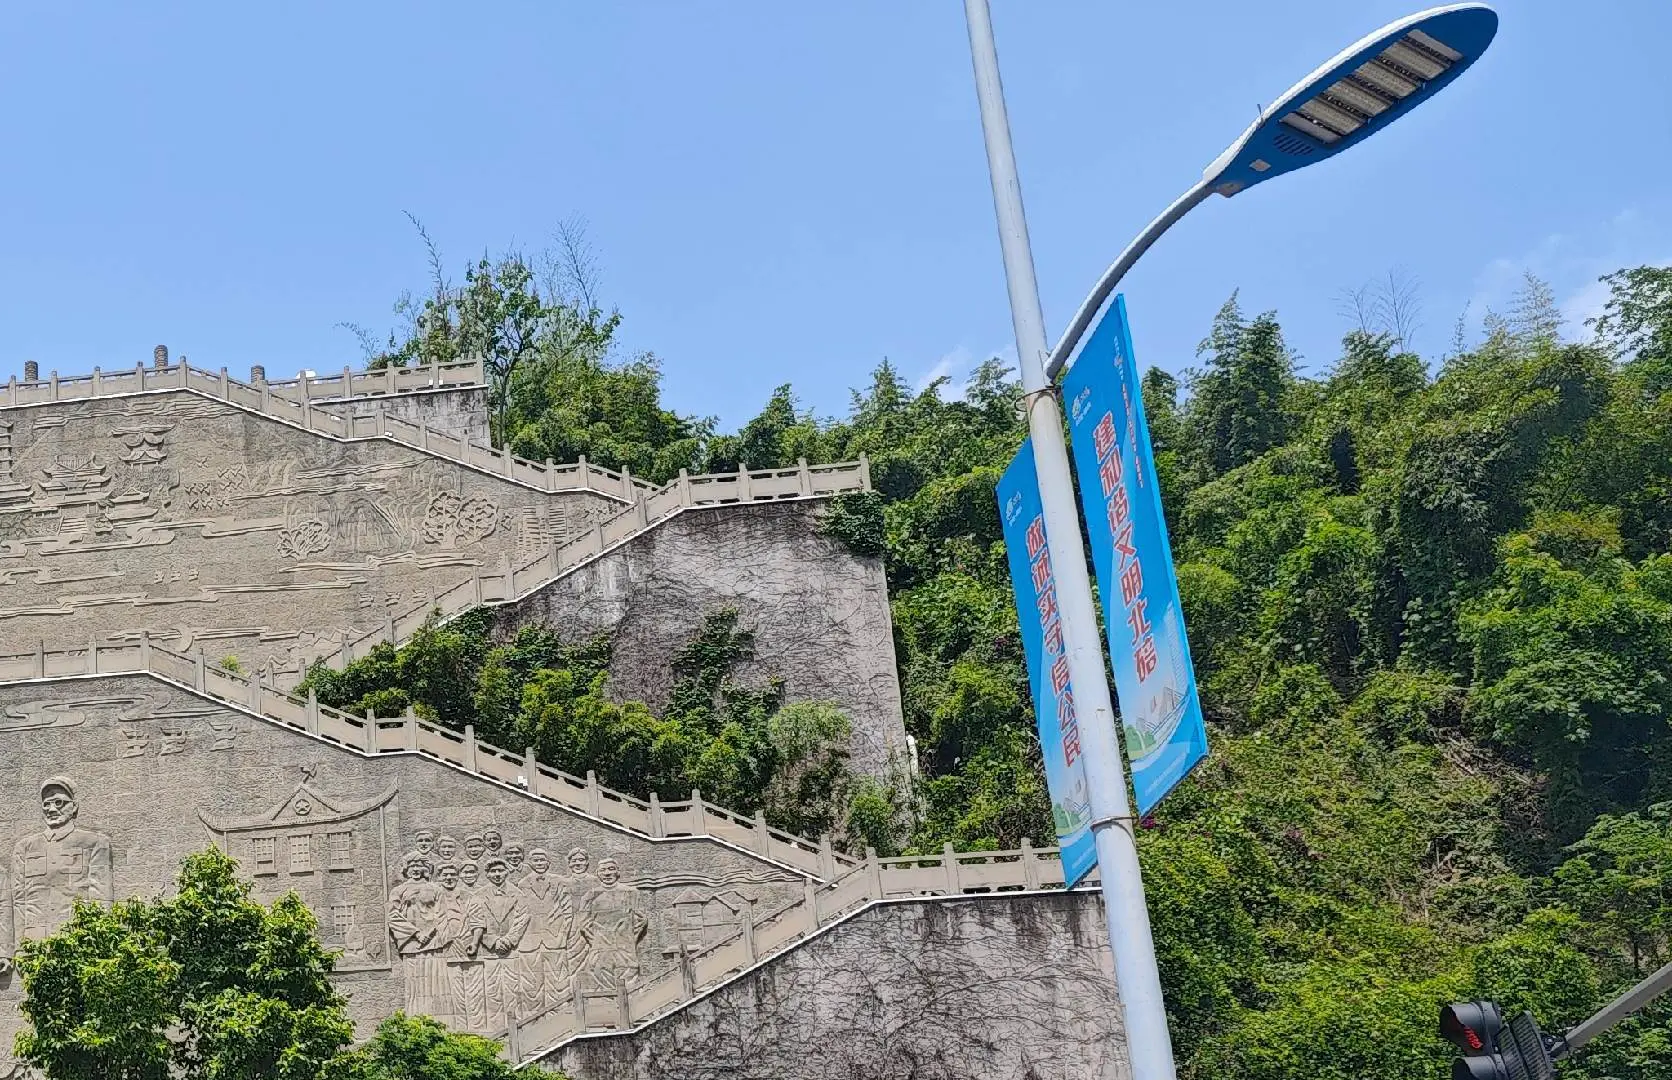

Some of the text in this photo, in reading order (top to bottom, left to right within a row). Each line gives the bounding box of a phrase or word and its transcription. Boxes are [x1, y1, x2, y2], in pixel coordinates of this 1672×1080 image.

[1026, 512, 1081, 768] 做诚实守信公民
[1094, 411, 1159, 684] 建和谐文明北碚
